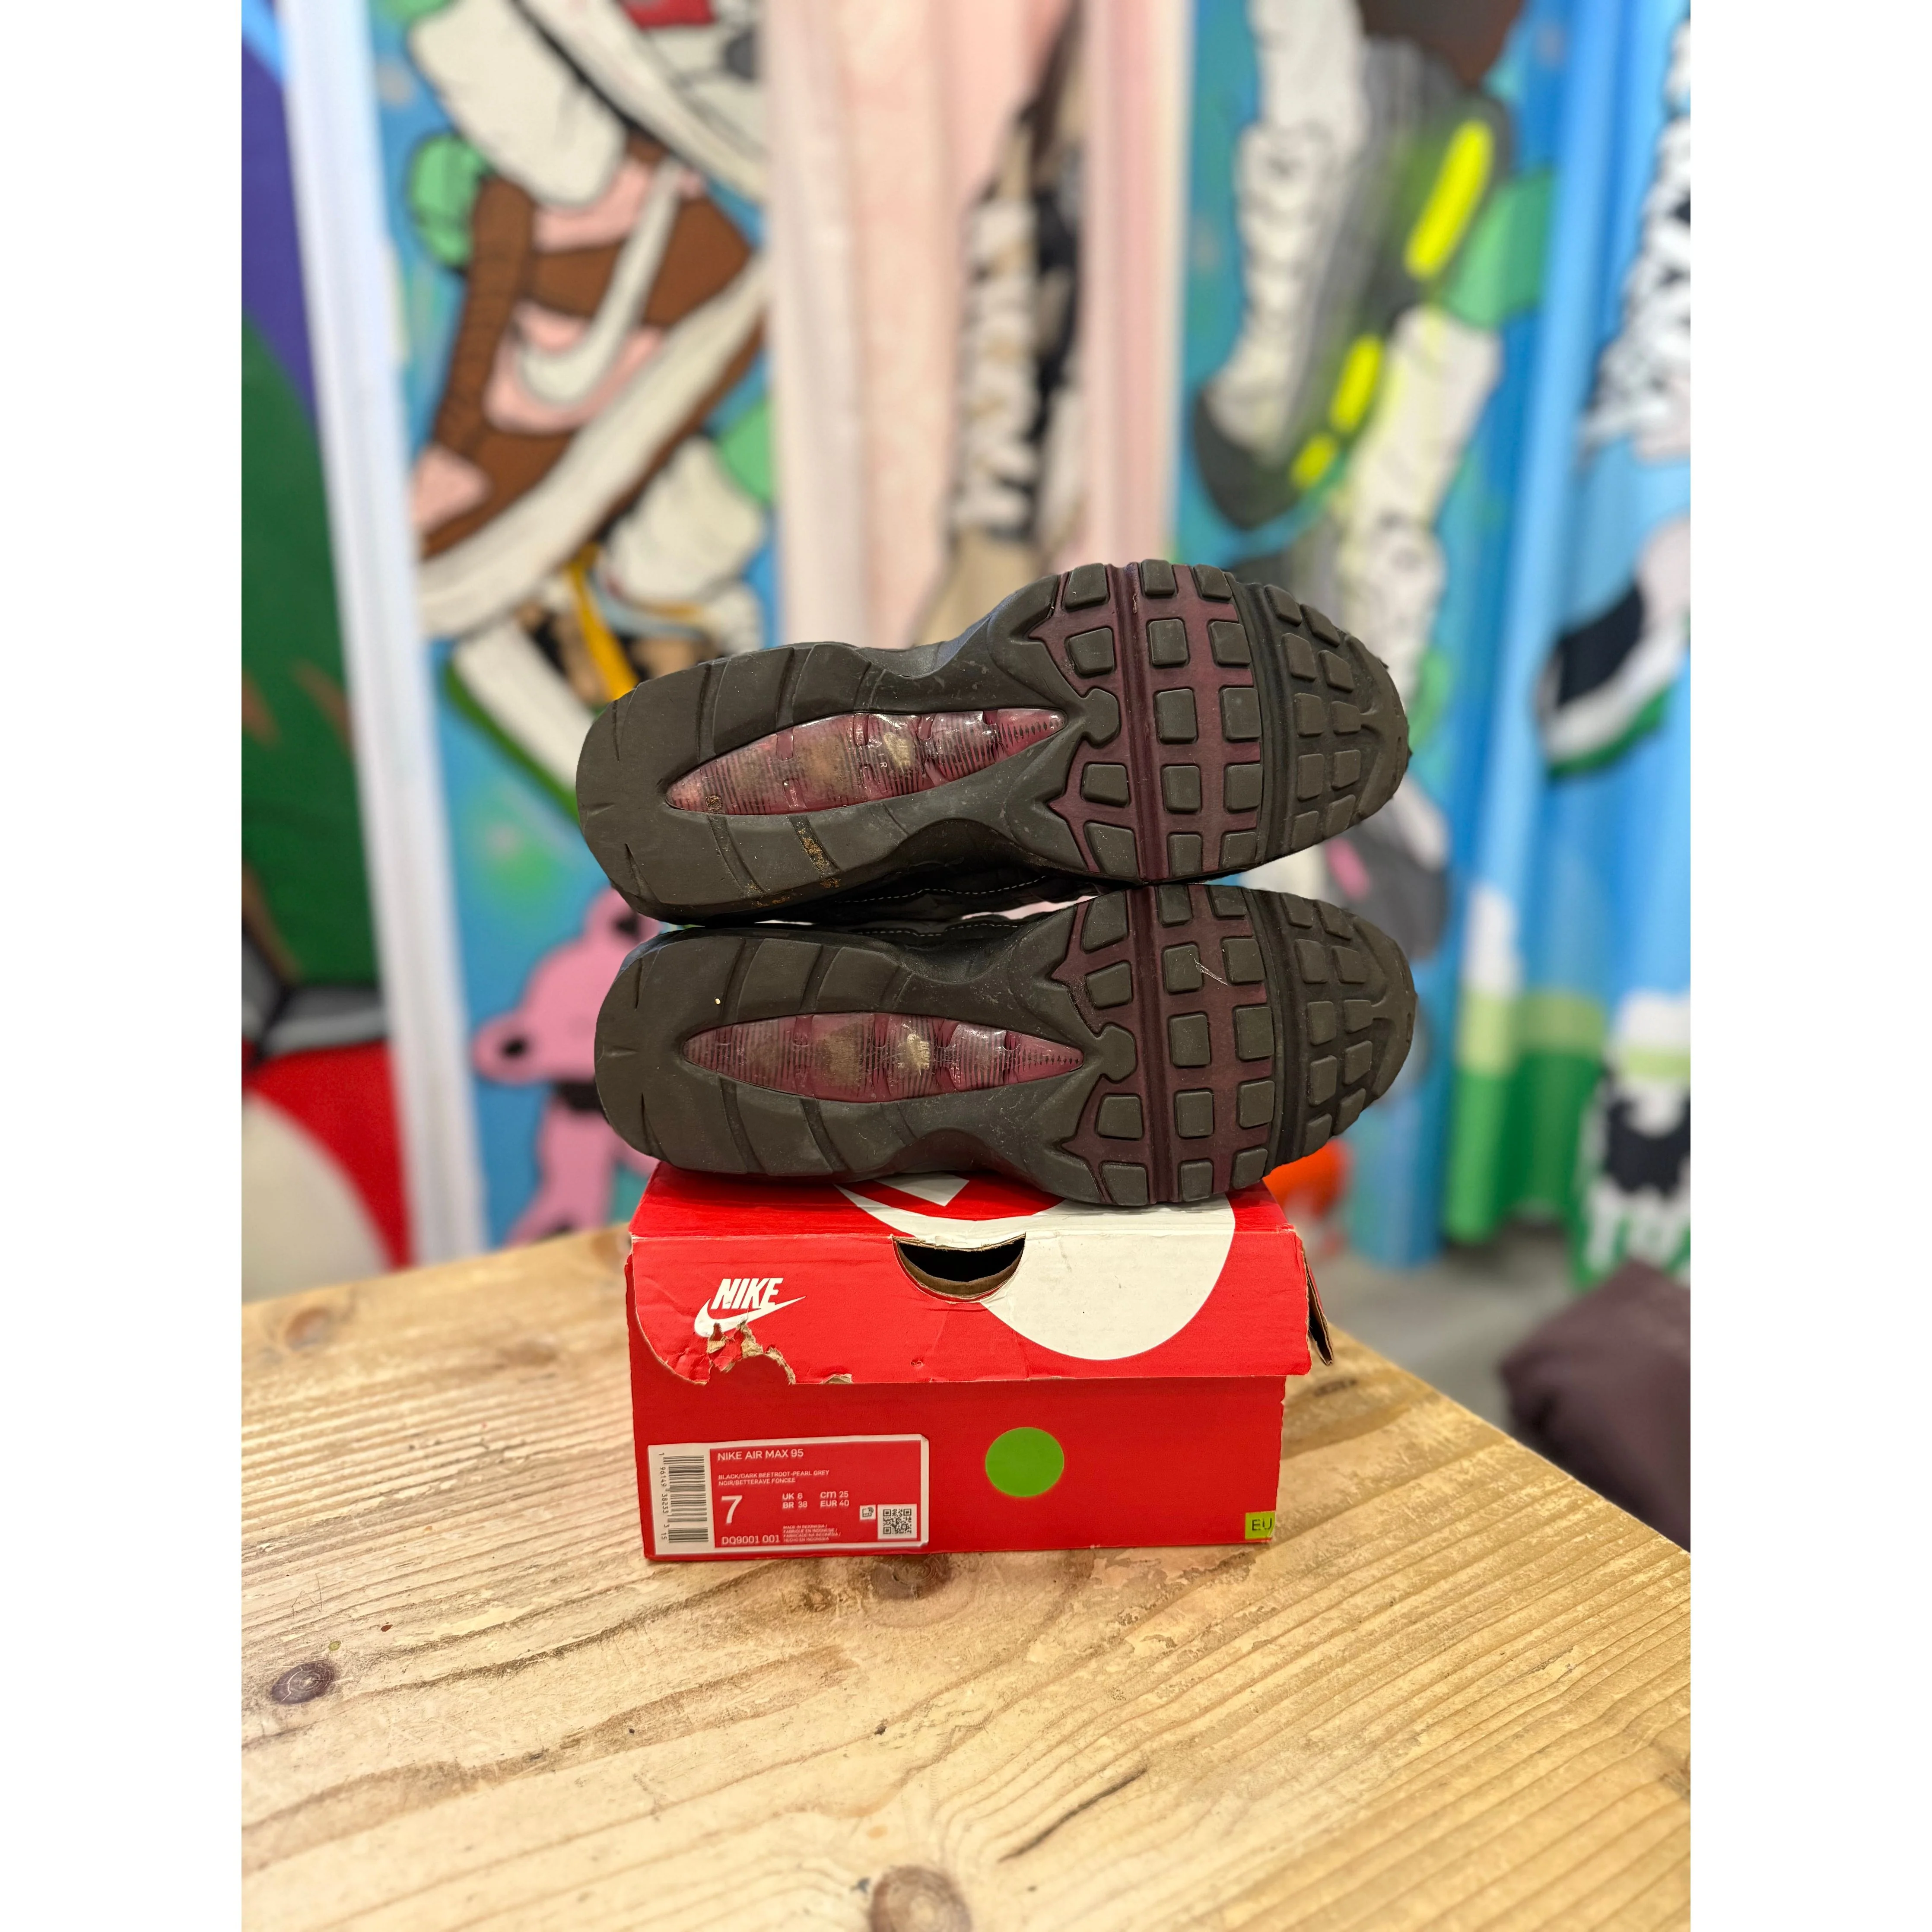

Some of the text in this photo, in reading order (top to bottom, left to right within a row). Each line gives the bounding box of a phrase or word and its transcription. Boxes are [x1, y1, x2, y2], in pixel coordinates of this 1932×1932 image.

[710, 1277, 784, 1309] NIKE
[717, 1449, 804, 1461] NIKE AIR MAX 95
[721, 1495, 743, 1525] 7
[1252, 1518, 1272, 1531] EU
[721, 1535, 780, 1545] DQ9001 001
